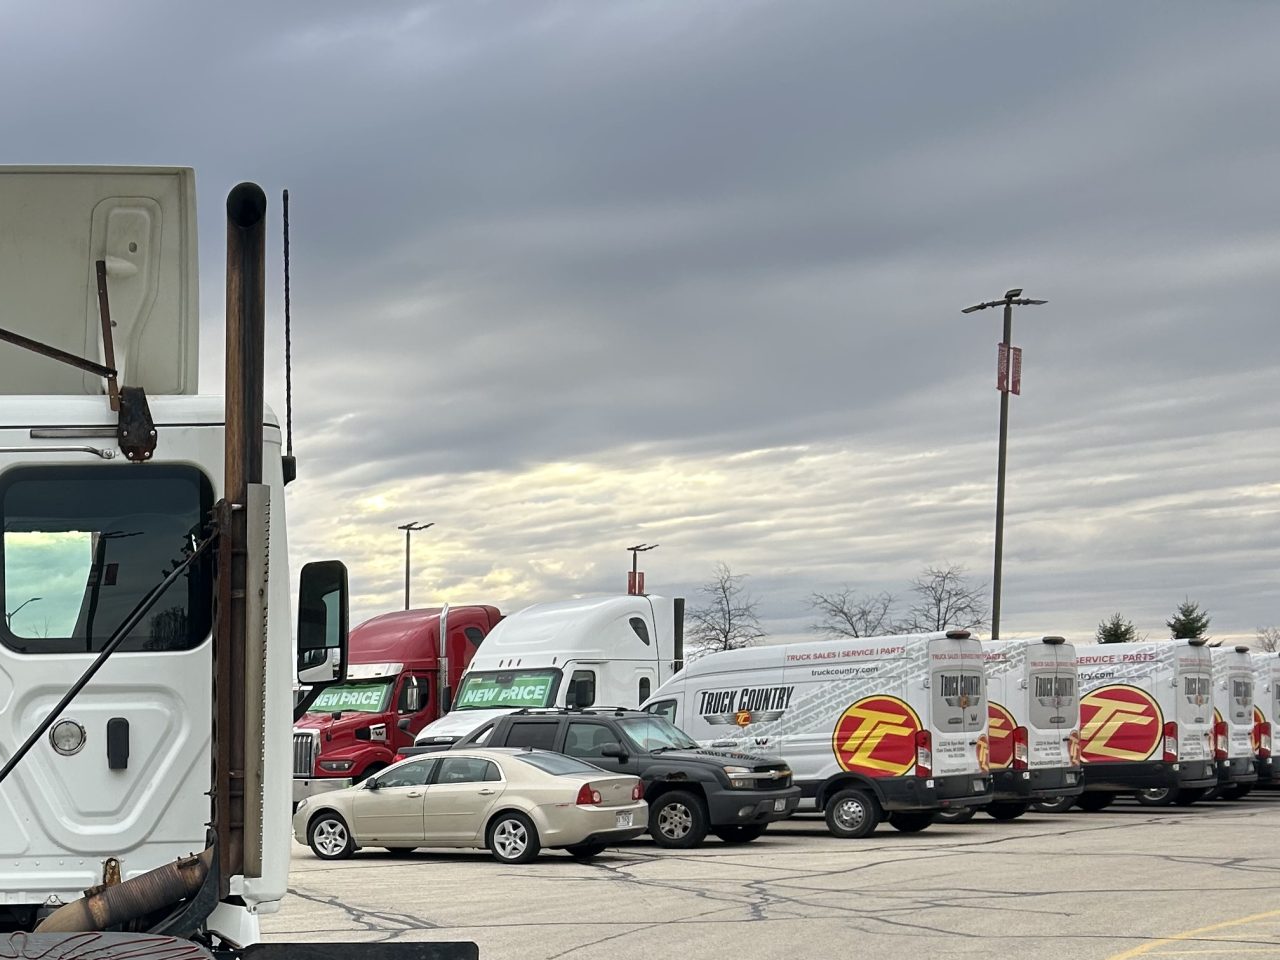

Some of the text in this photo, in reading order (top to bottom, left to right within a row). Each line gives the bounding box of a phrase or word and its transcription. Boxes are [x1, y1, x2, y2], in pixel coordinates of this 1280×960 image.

[813, 651, 836, 660] SALES
[842, 648, 874, 658] SERVICE
[880, 646, 905, 654] PARTS
[1076, 653, 1155, 664] SERVICE PARTS
[811, 666, 878, 676] truckcountry.com
[312, 692, 381, 706] NEW PRICE
[463, 685, 545, 703] NEW PRICE
[699, 686, 795, 715] TRUCK COUNTRY
